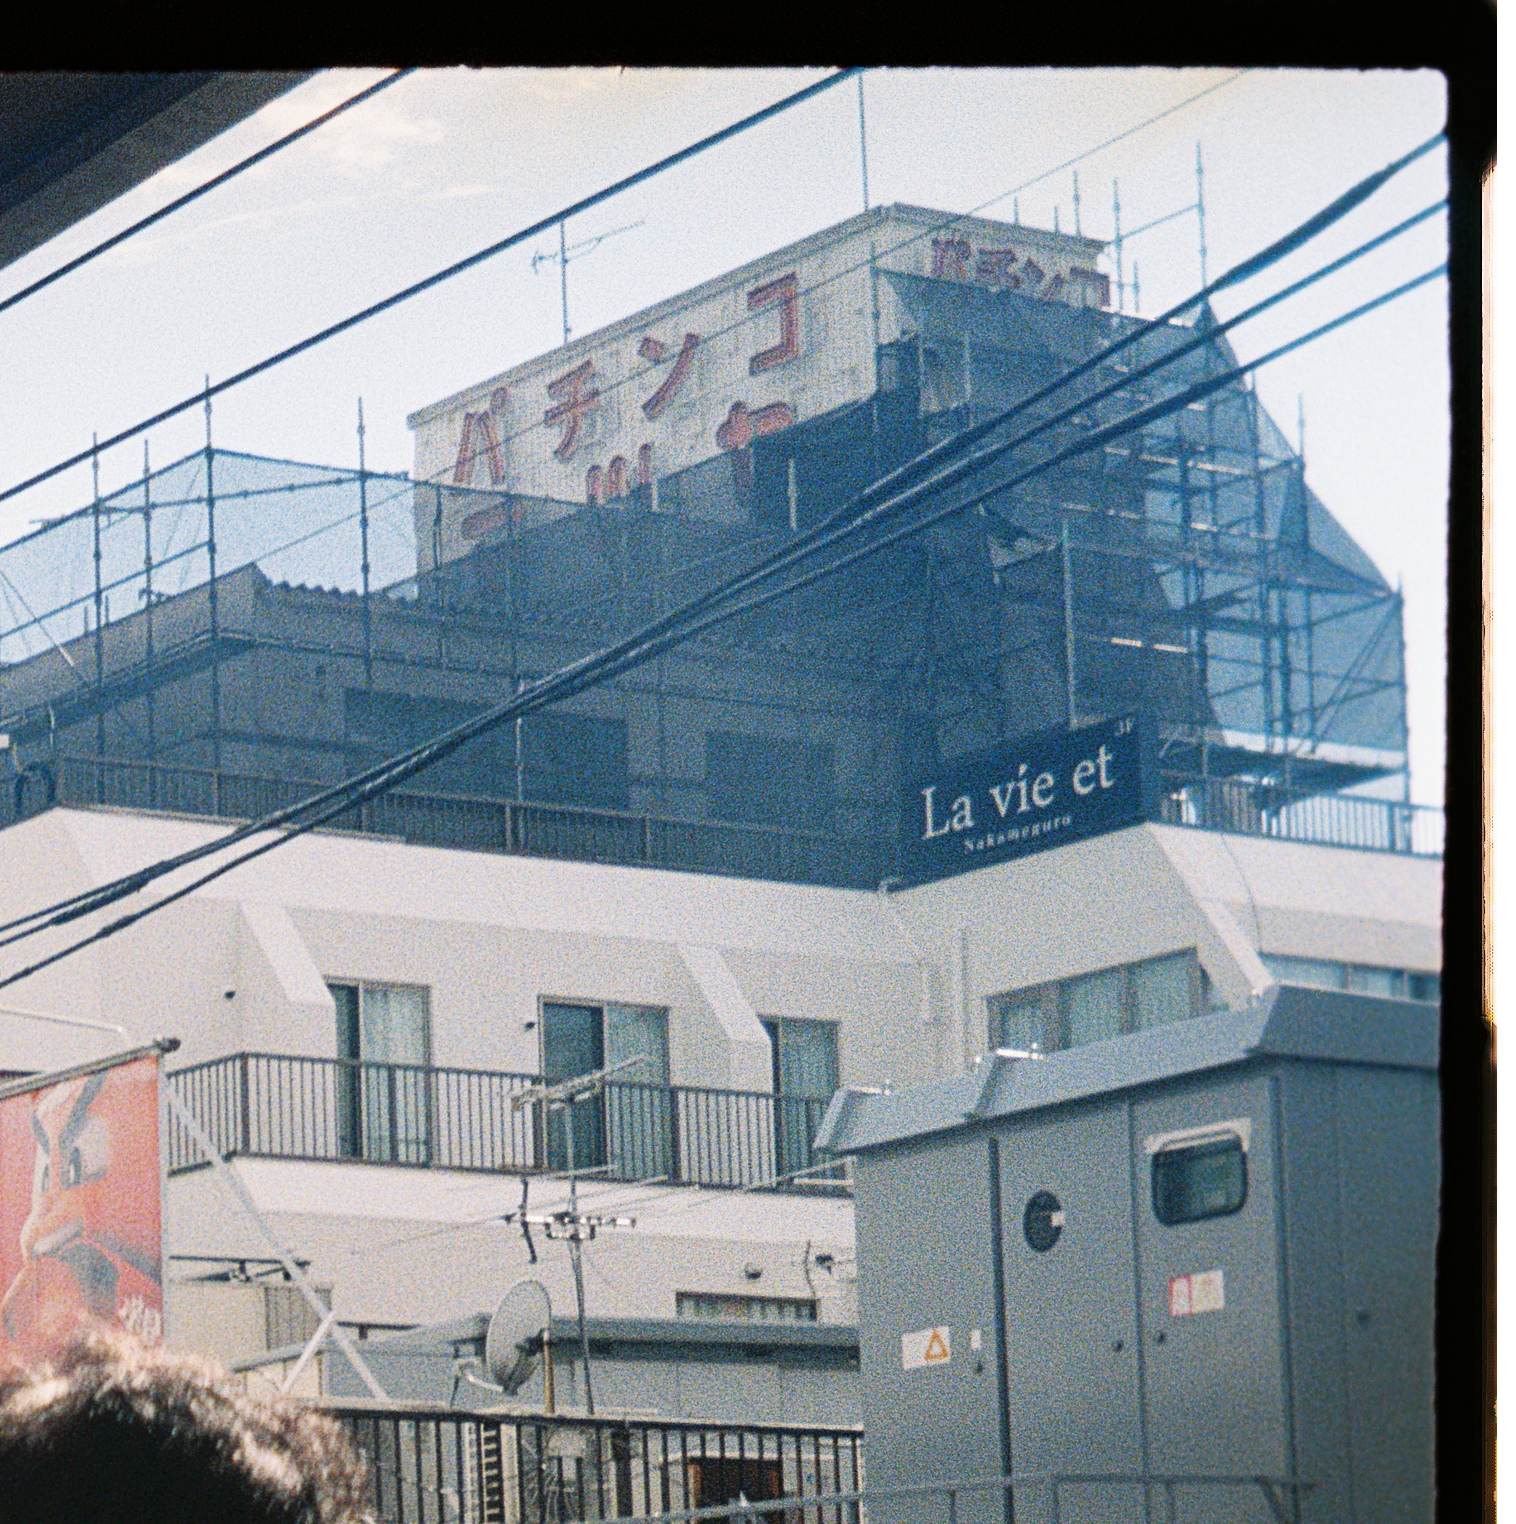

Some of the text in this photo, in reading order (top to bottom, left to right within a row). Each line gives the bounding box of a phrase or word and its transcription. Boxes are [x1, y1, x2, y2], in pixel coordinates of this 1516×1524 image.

[453, 271, 800, 487] パチンコ
[921, 744, 1114, 840] La vie et
[963, 813, 1072, 854] Nakameguro
